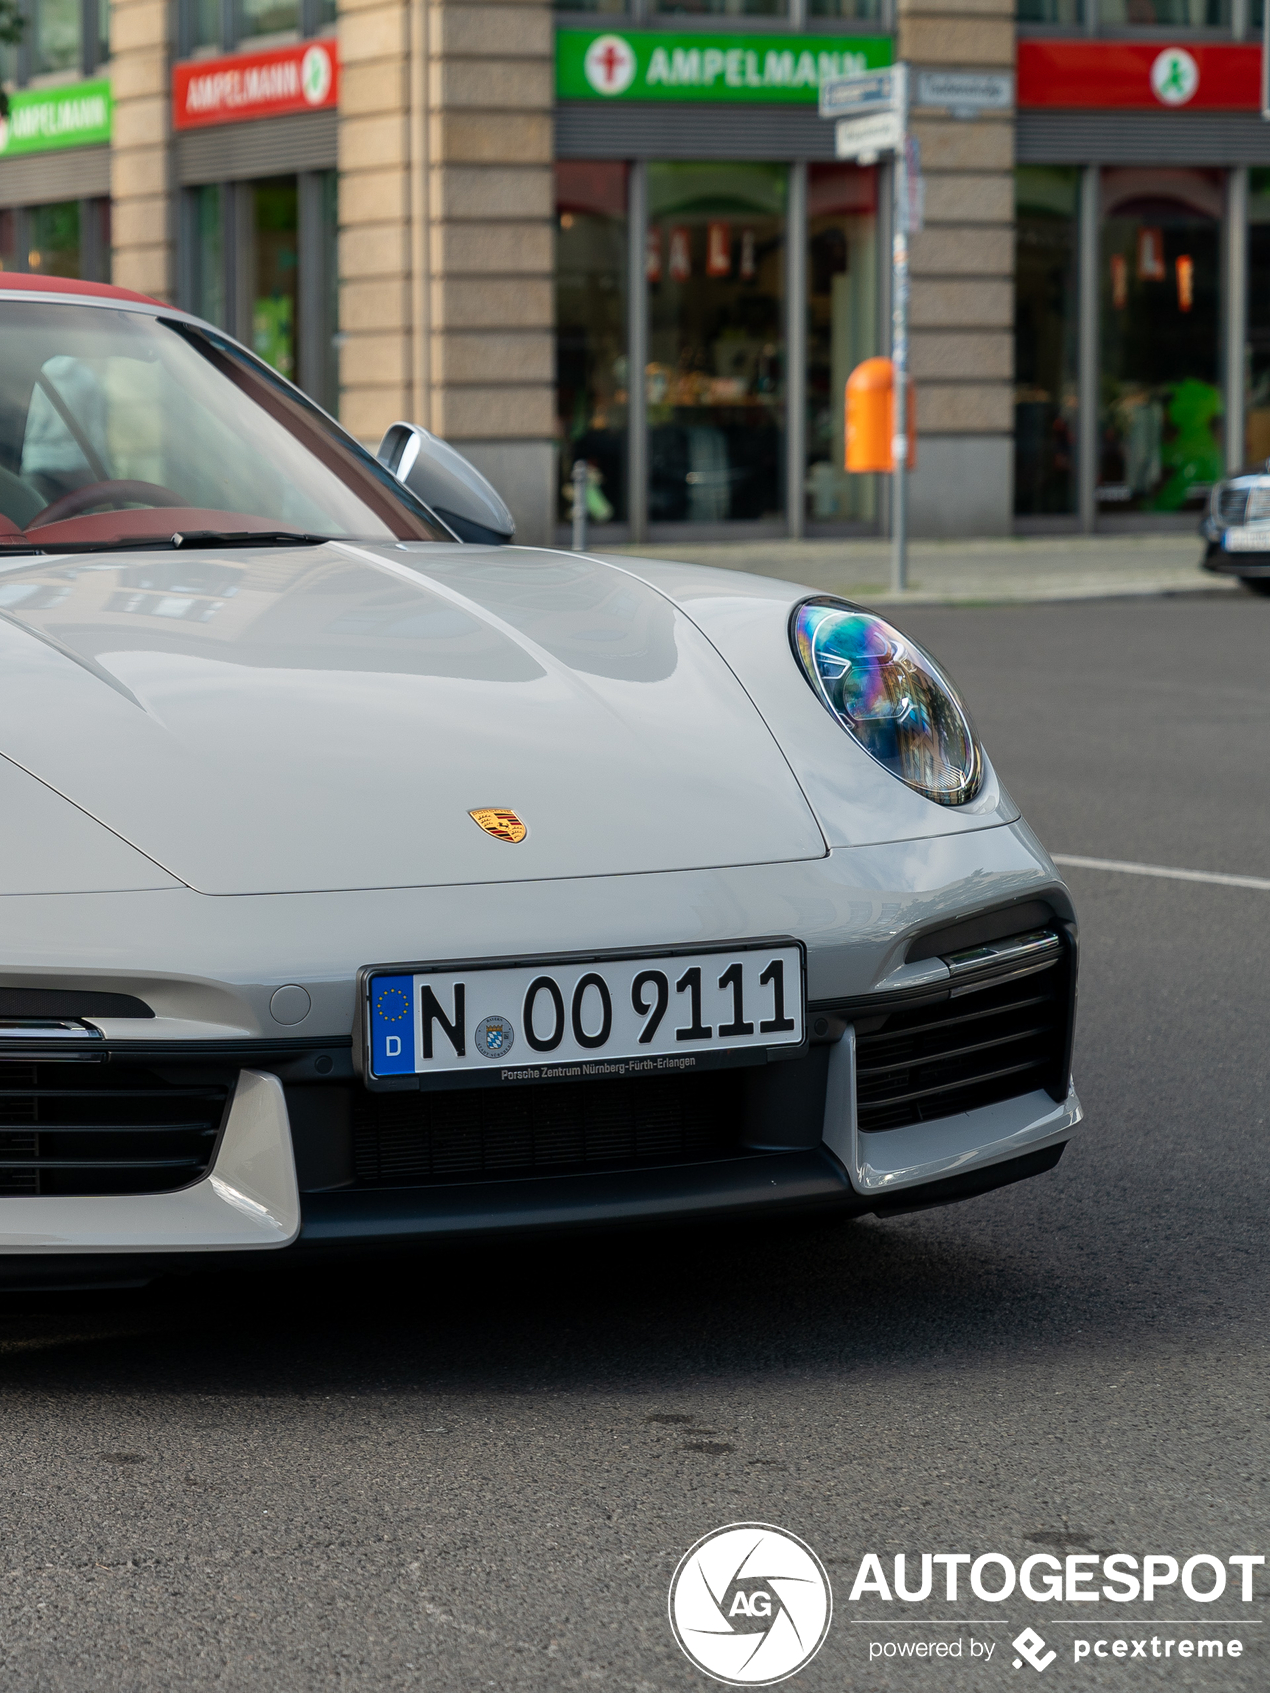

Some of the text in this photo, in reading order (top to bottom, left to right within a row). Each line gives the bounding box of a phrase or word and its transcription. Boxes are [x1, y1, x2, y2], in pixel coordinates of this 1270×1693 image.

[186, 60, 299, 114] AMPELMANN
[9, 95, 107, 139] AMPELMANN
[421, 982, 466, 1060] N
[631, 958, 795, 1044] 9111
[386, 1035, 402, 1057] D
[501, 1057, 696, 1081] Porsche Zentrum Nürnberg-Fürth-Erlangen
